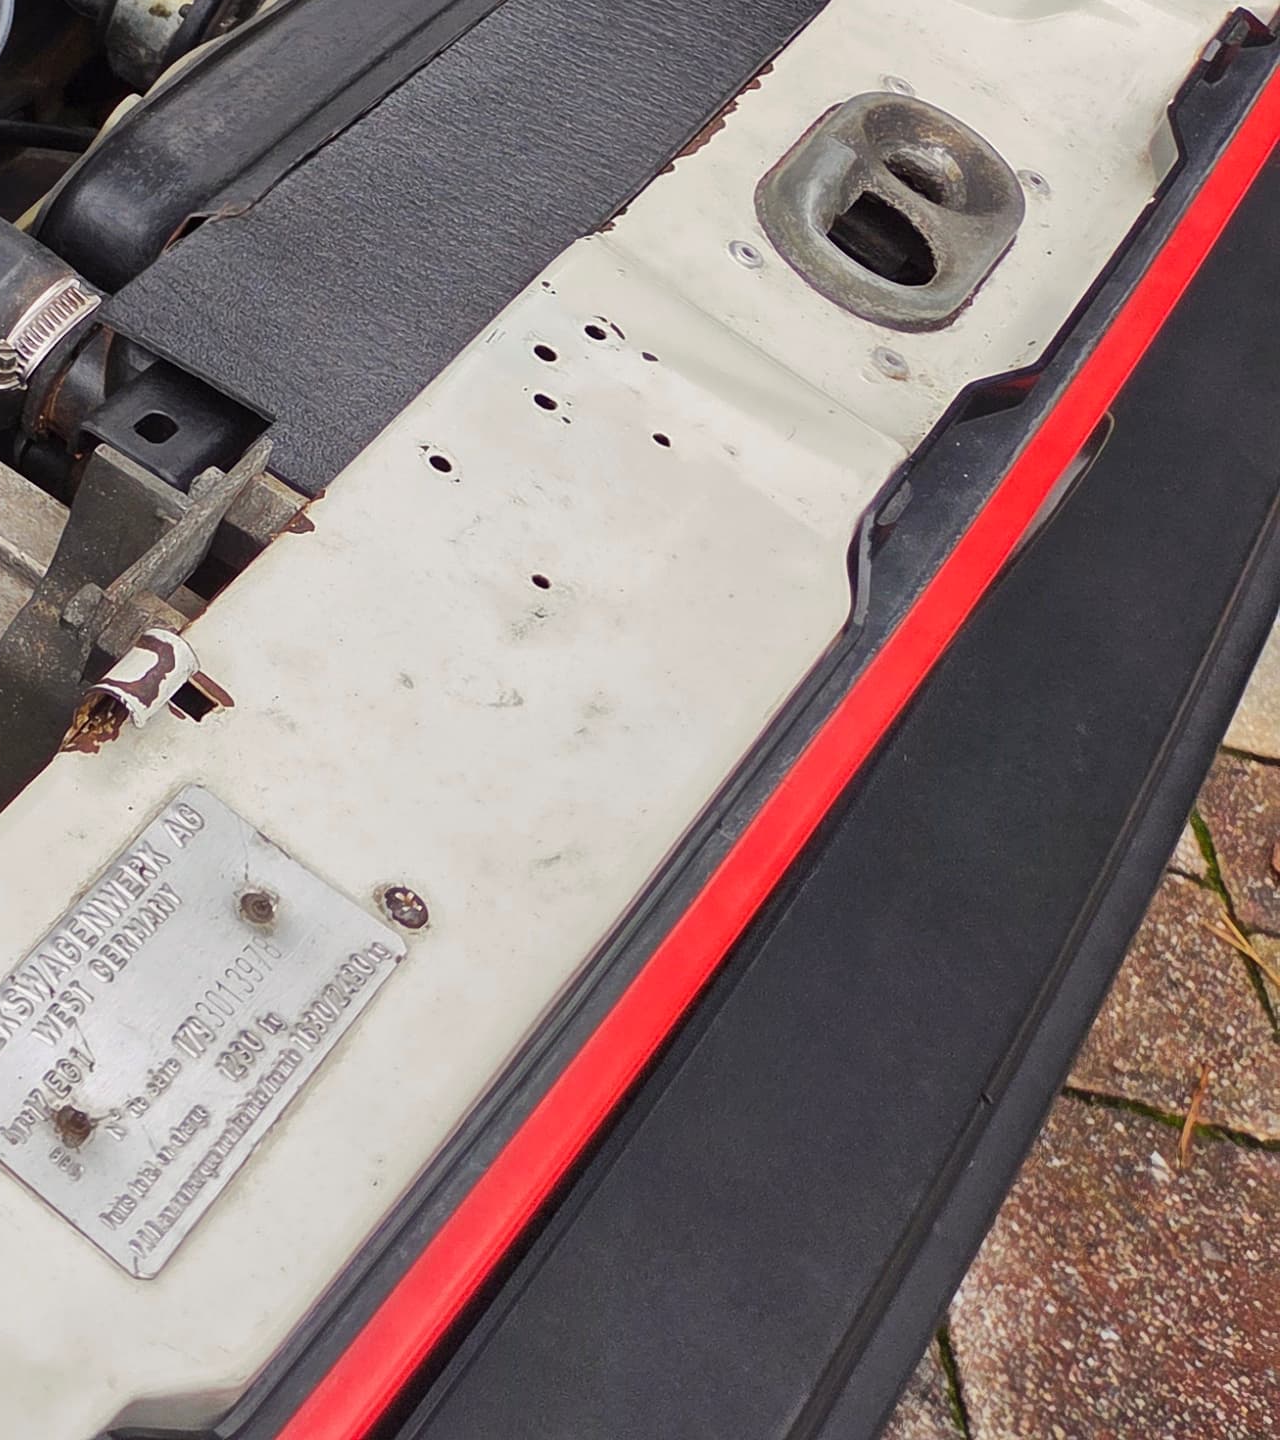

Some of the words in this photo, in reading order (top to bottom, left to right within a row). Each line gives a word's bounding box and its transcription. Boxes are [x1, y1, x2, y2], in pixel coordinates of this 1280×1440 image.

[159, 804, 206, 844] AG
[32, 983, 94, 1045] WEST
[88, 884, 183, 982] GERMANY
[214, 1030, 266, 1082] 1230
